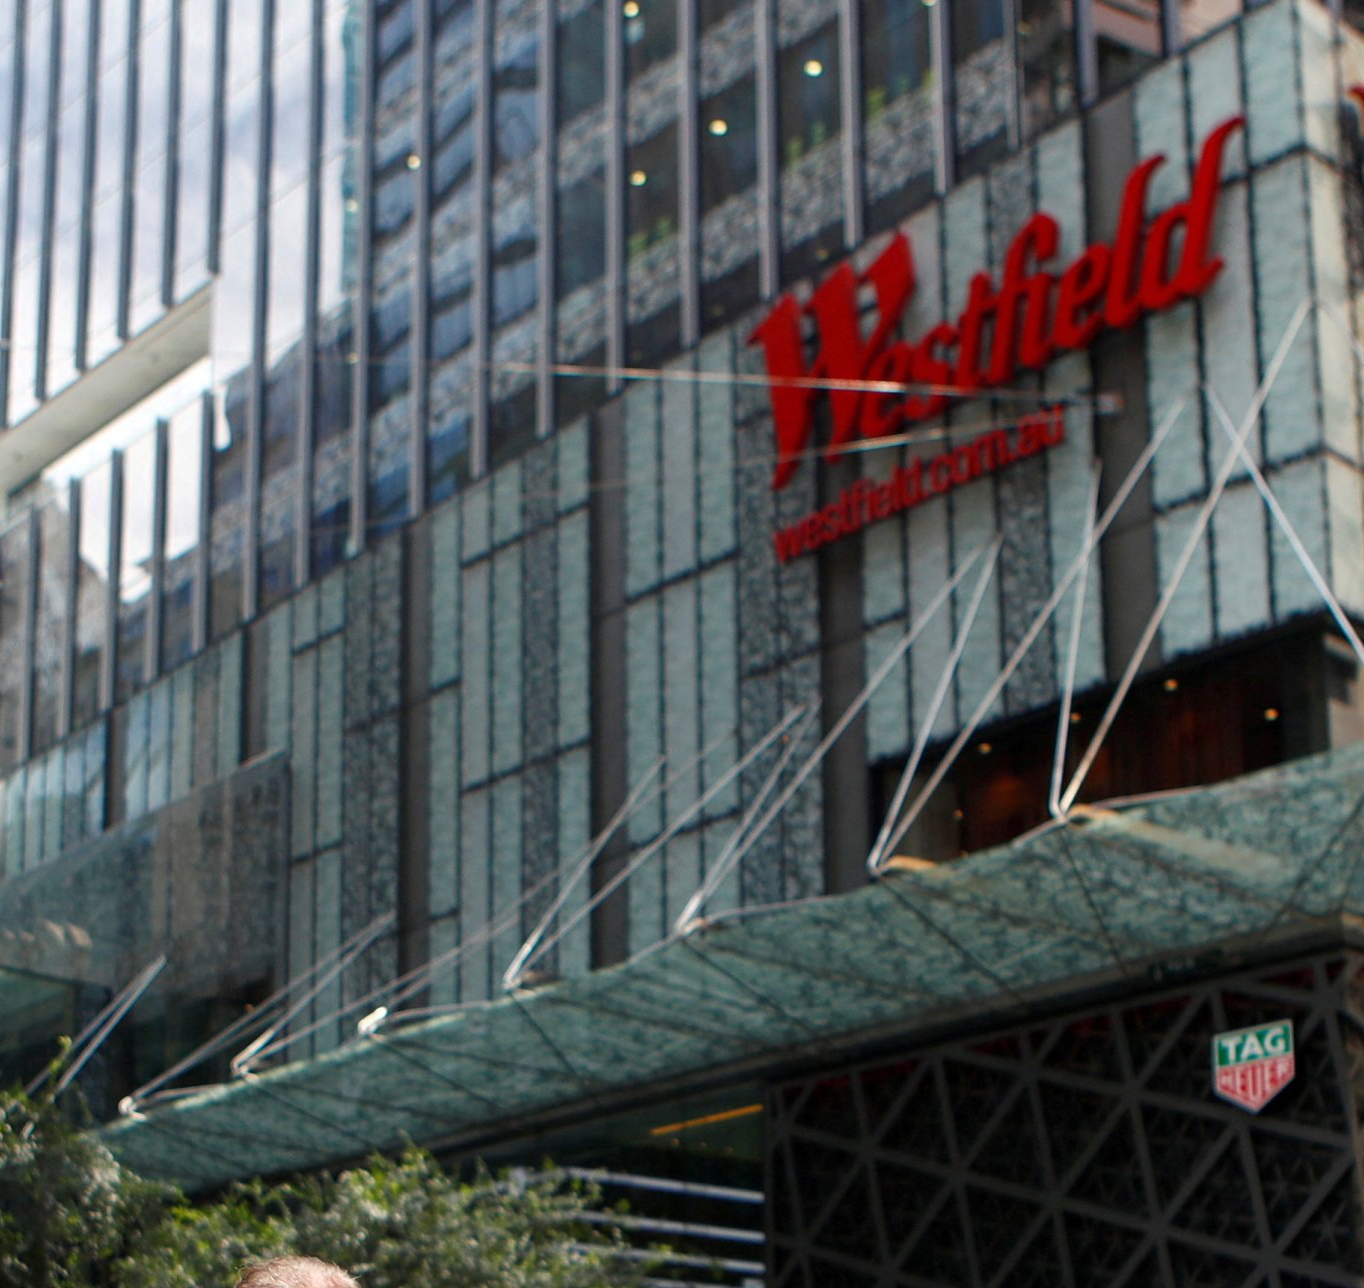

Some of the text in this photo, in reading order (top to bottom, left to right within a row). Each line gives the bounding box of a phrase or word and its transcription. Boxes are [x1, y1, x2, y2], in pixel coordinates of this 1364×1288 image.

[747, 116, 1245, 490] Westfield
[772, 403, 1068, 565] westfield.com.au
[1217, 1054, 1293, 1108] HEUER
[1220, 1026, 1288, 1065] TAG
